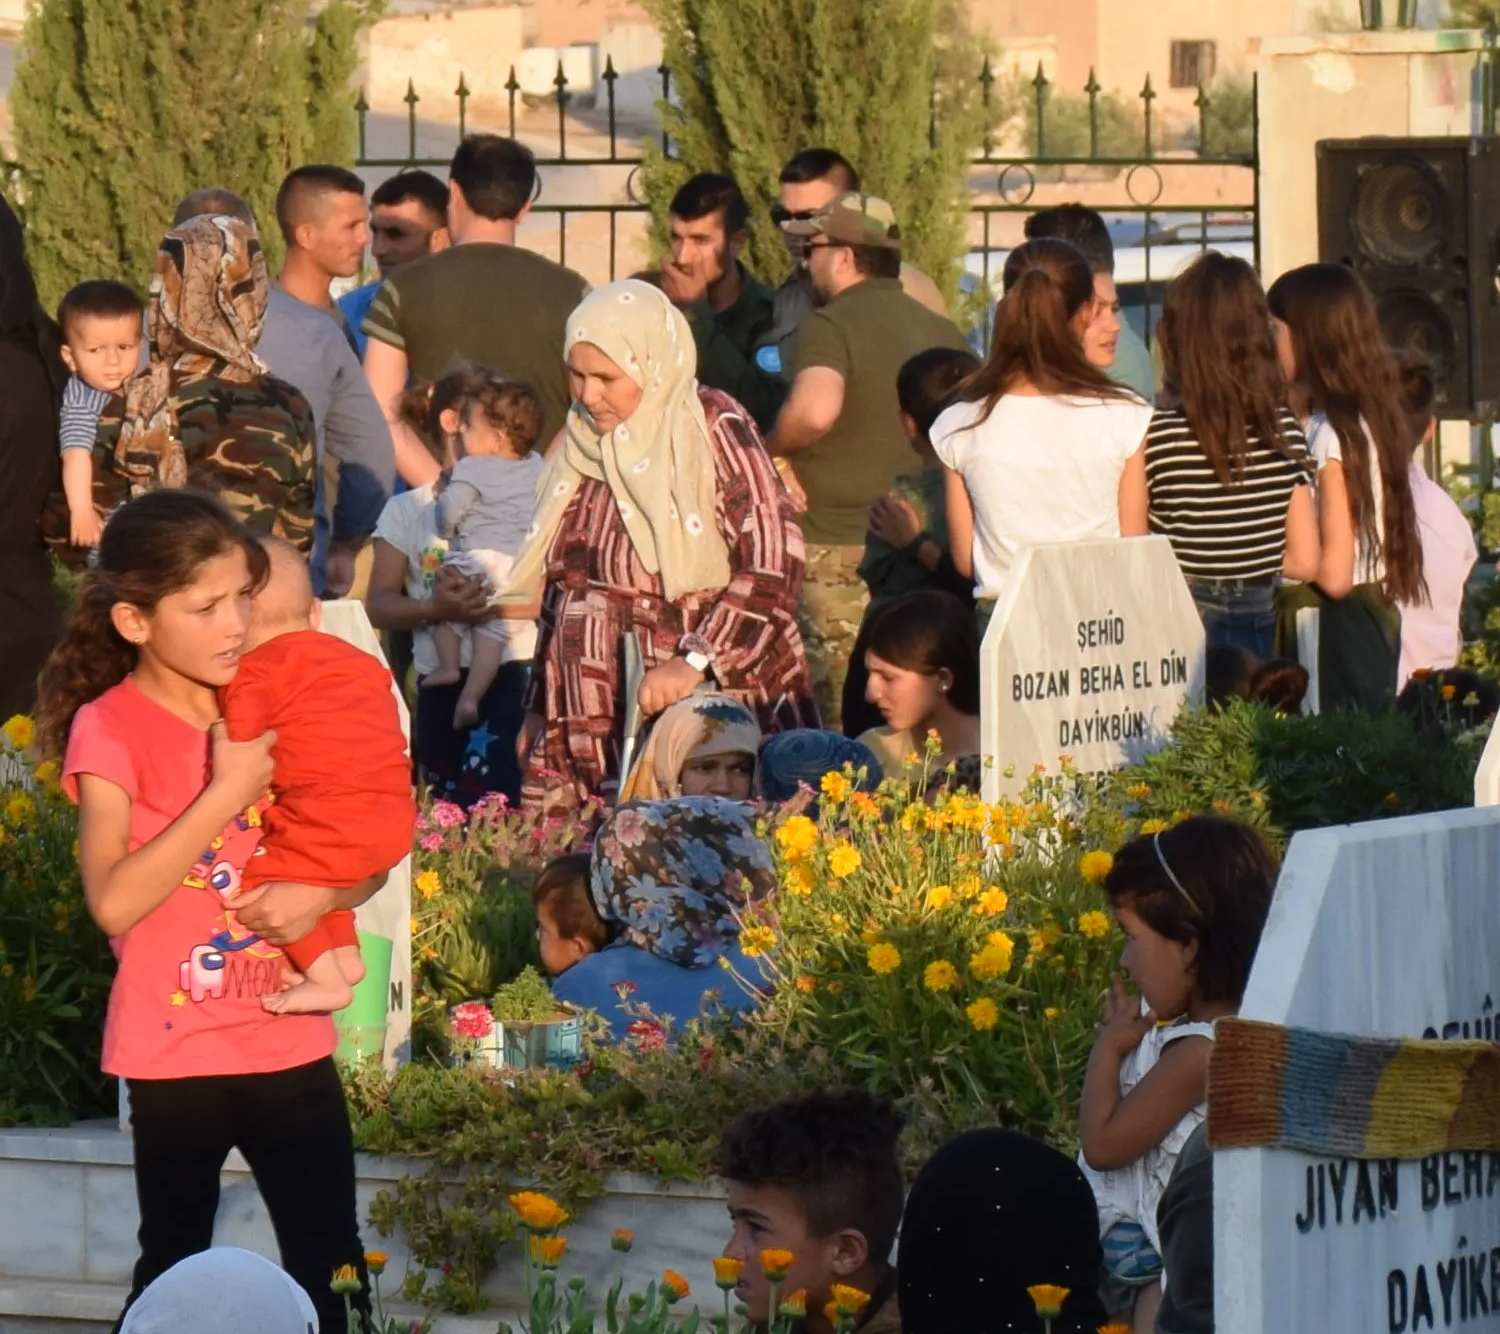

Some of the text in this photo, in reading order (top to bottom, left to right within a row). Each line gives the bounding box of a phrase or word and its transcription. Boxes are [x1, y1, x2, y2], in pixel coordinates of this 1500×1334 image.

[1012, 669, 1070, 702] BOZAN
[1080, 664, 1125, 695] BEHA
[1132, 661, 1152, 689] EL
